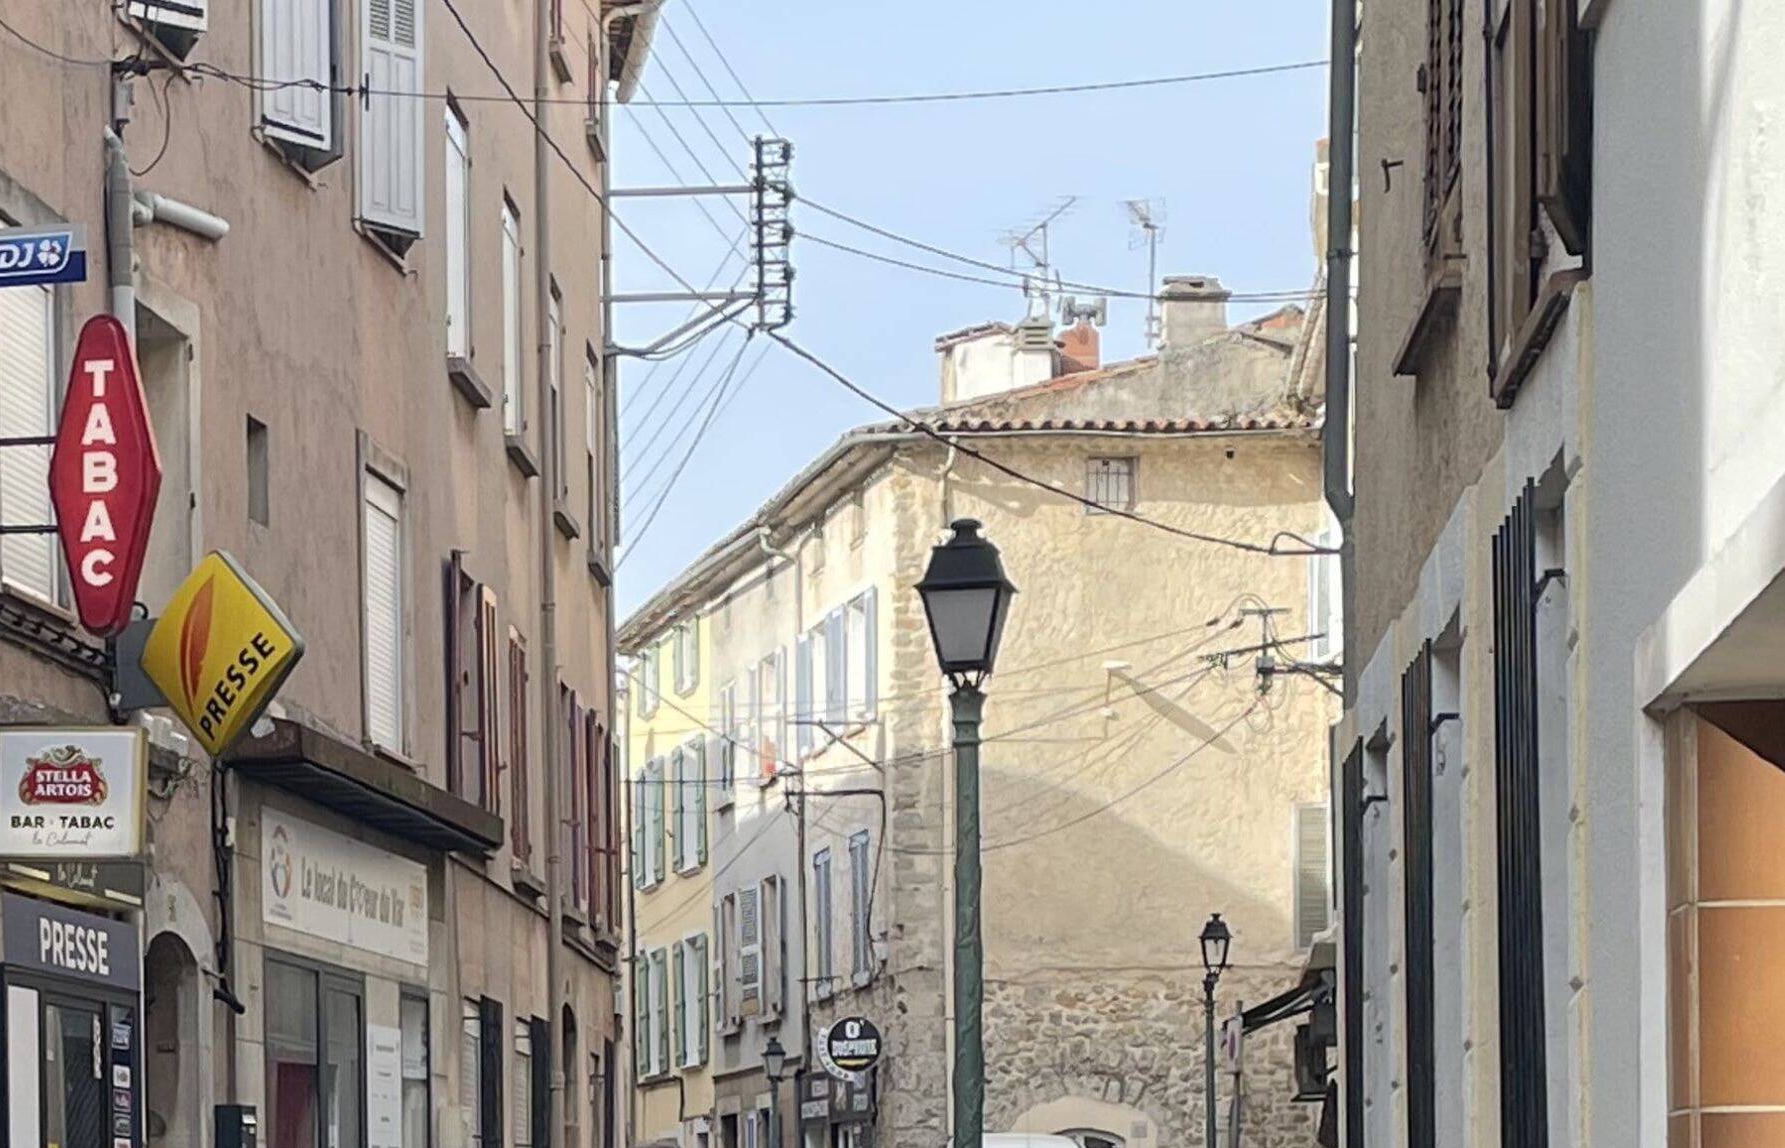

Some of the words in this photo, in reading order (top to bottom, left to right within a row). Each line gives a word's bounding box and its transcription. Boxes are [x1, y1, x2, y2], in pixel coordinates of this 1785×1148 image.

[80, 360, 118, 586] TABAC
[198, 632, 276, 740] PRESSE
[34, 784, 93, 797] ARTOIS
[35, 770, 92, 783] STELLA
[11, 816, 45, 829] BAR
[59, 816, 115, 829] TABAC
[40, 917, 109, 976] PRESSE
